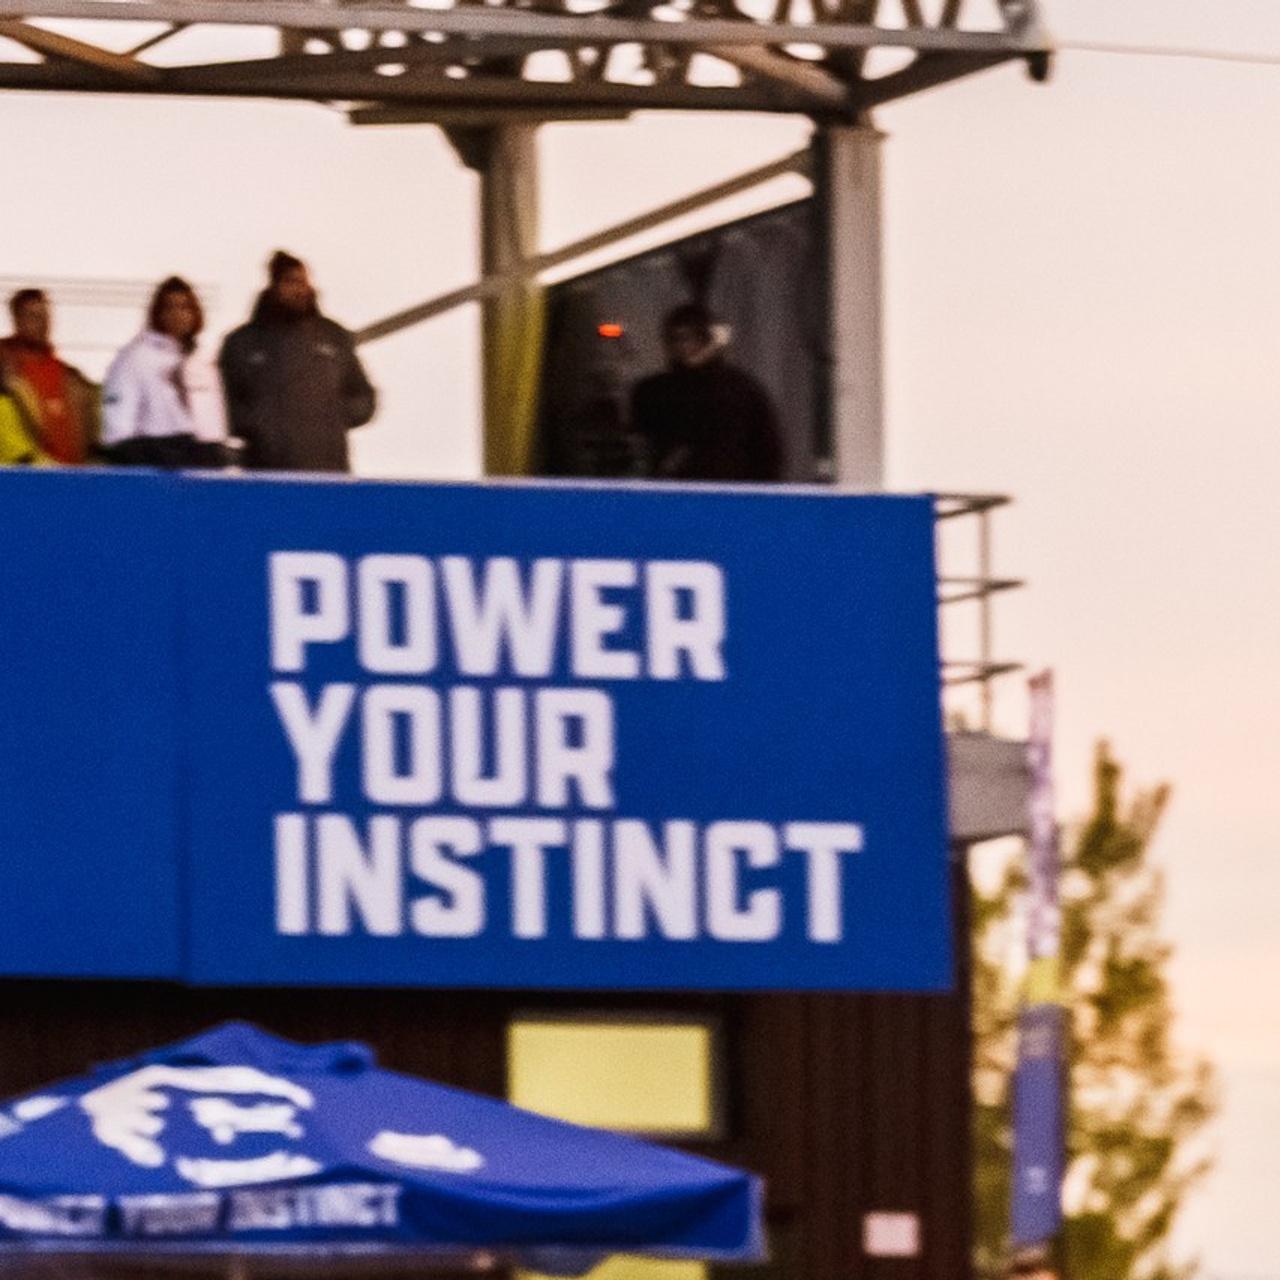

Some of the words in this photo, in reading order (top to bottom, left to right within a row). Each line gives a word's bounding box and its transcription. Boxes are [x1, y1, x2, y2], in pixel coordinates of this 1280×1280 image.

[268, 551, 726, 681] POWER
[268, 682, 616, 808] YOUR
[275, 812, 863, 943] INSTINCT
